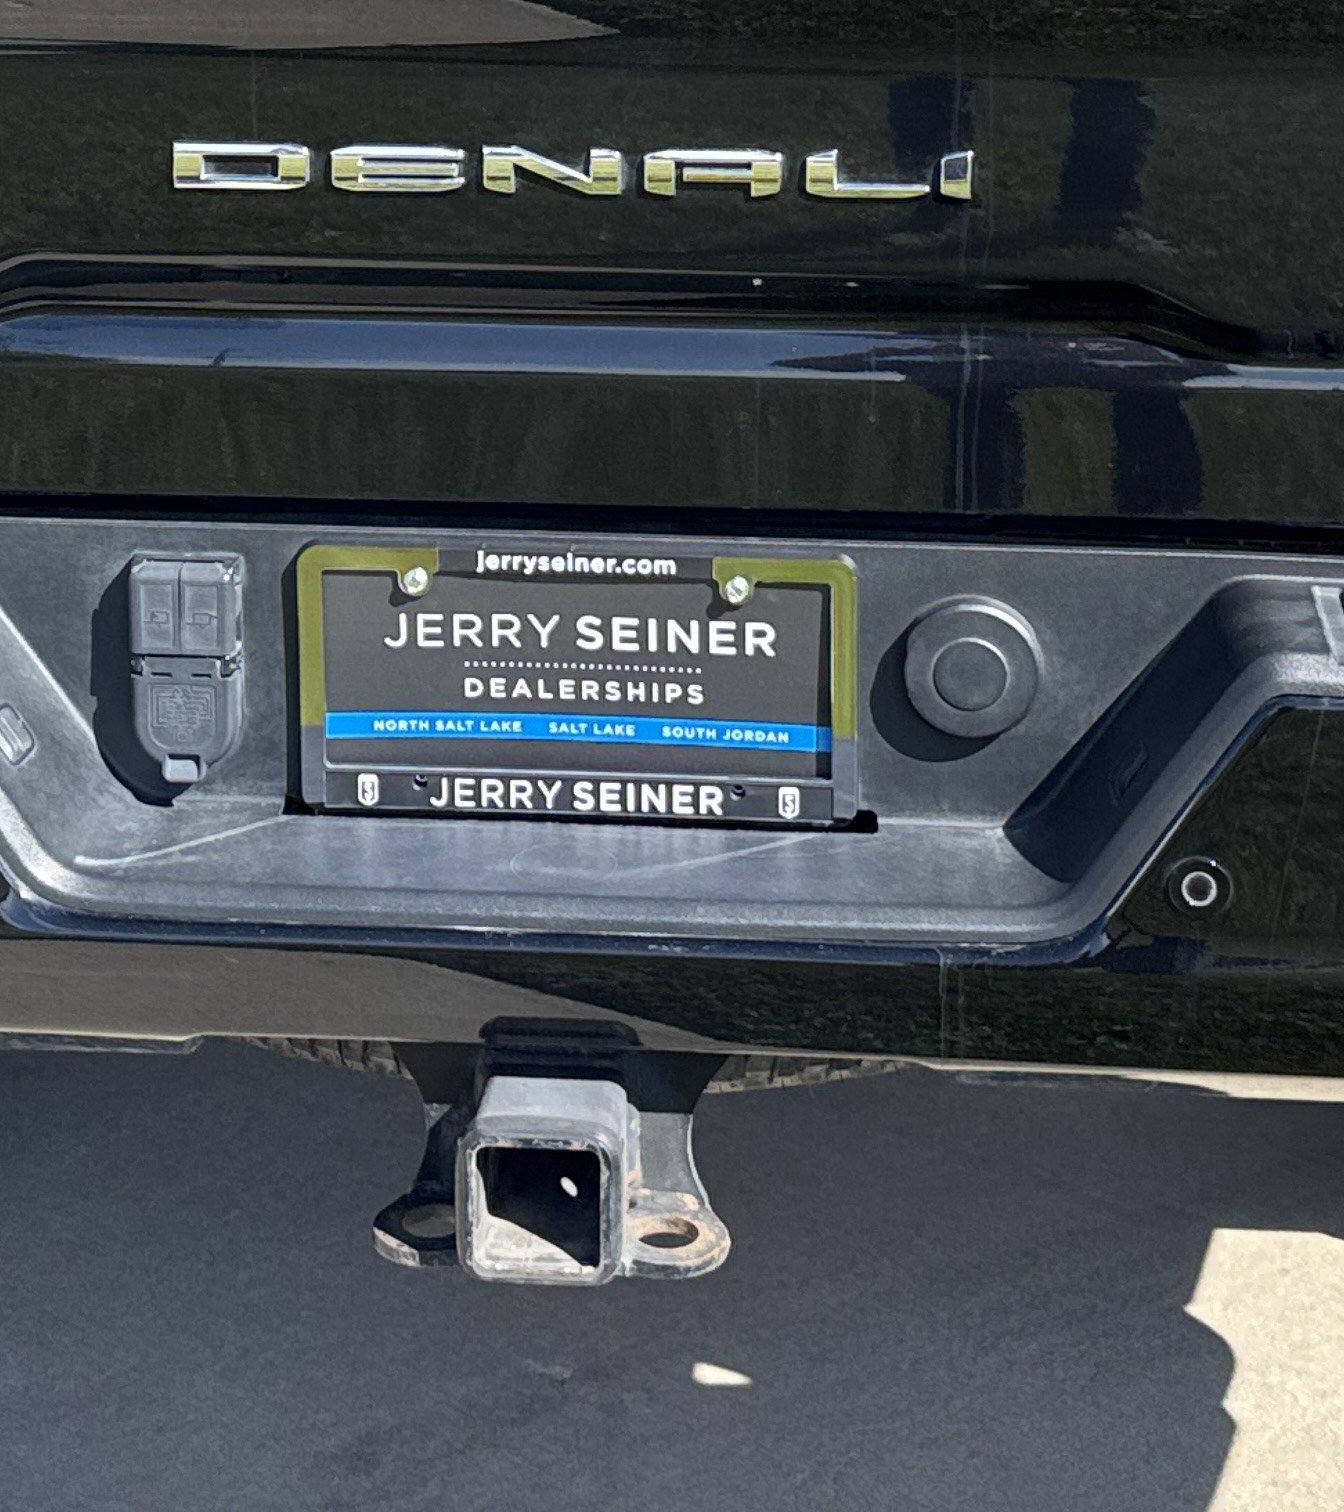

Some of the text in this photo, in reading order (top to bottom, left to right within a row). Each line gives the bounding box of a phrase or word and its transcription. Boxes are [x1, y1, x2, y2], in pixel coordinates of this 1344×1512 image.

[171, 141, 975, 200] DENALI
[475, 548, 677, 577] jerryseiner.com
[383, 612, 777, 658] JERRY SEINER
[463, 676, 705, 705] DEALERSHIPS
[372, 718, 523, 733] NORTH SALT LAKE
[548, 721, 636, 738] SALT LAKE
[661, 724, 790, 744] SOUTH JORDAN
[429, 776, 724, 816] JERRY SEINER
